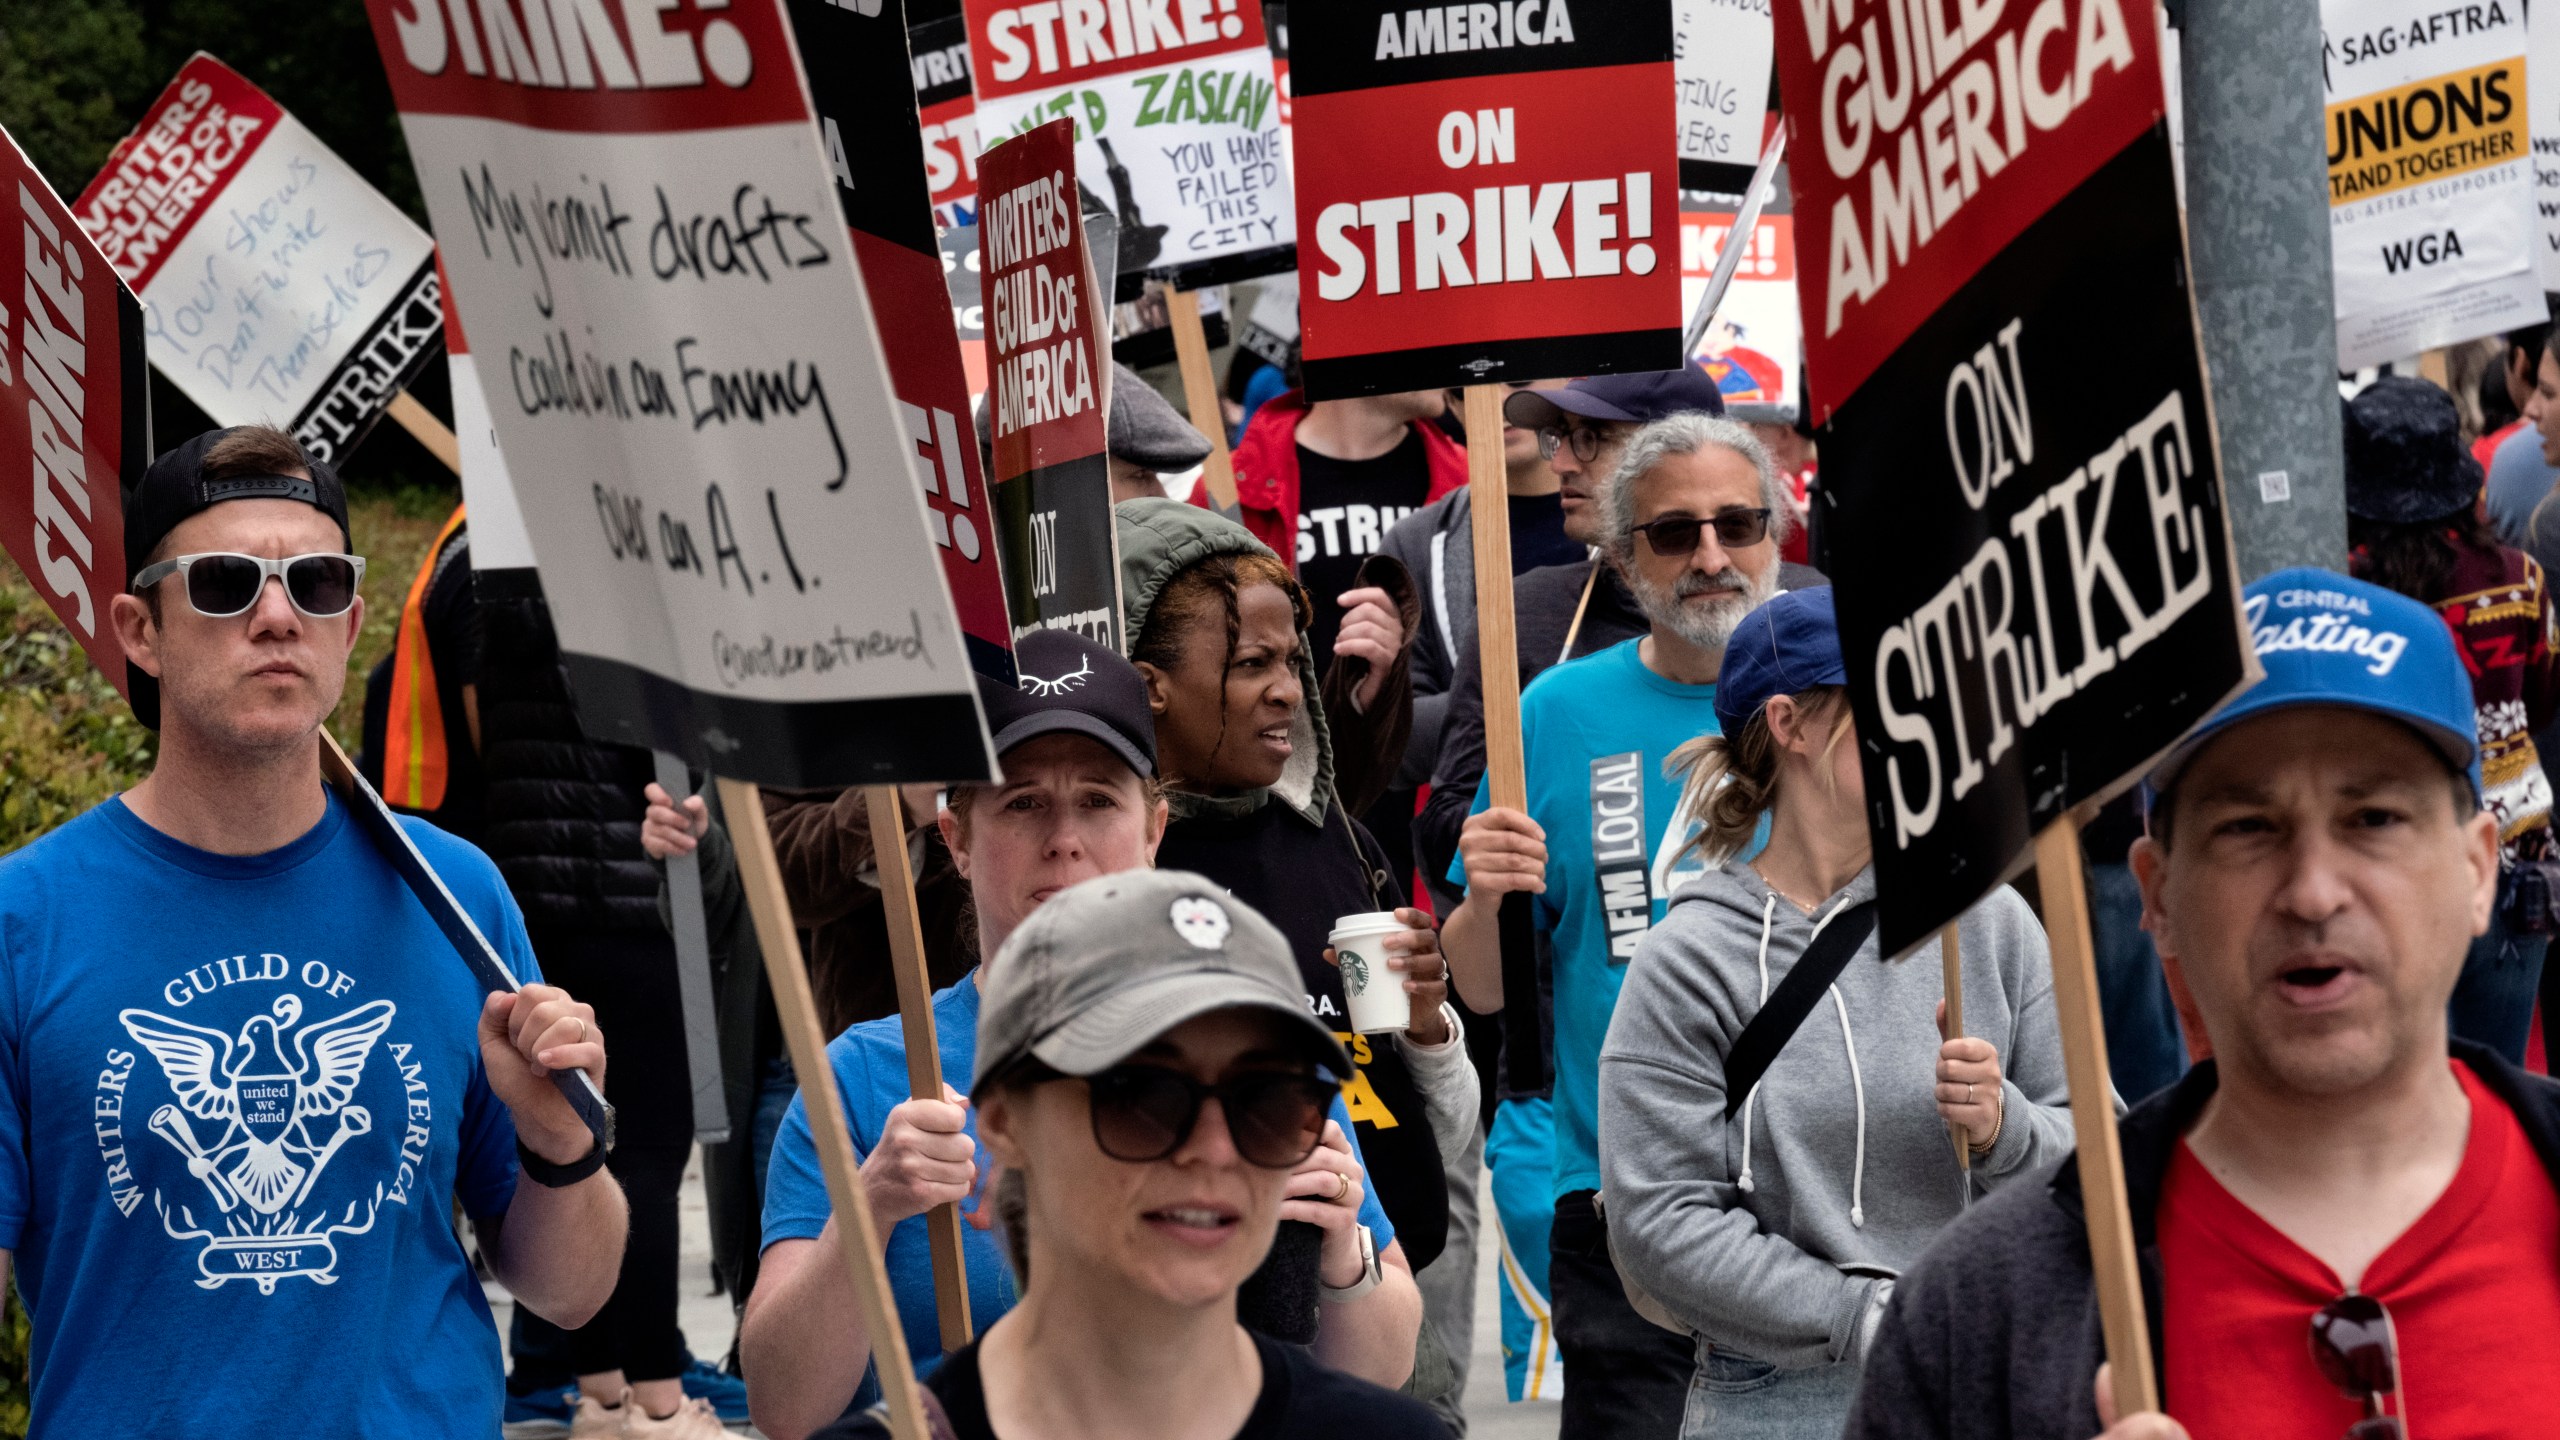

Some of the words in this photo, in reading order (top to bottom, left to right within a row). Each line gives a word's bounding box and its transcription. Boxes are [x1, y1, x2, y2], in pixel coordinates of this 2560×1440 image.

[986, 0, 1244, 82] STRIKE!
[1375, 0, 1574, 61] AMERICA
[1133, 69, 1274, 133] ZASLAV
[1675, 78, 1737, 116] TING
[1161, 142, 1213, 174] YOU
[1227, 128, 1280, 165] HAVE
[1438, 107, 1516, 169] ON
[1677, 121, 1731, 157] ERS
[1826, 0, 2135, 339] AMERICA
[2328, 163, 2392, 199] TAND
[2395, 130, 2515, 181] TOGETHER
[95, 143, 195, 262] GUILD
[190, 103, 228, 150] OF
[1177, 161, 1276, 206] FAILED
[1203, 195, 1260, 225] THIS
[2427, 165, 2519, 201] SUPPORTS
[460, 162, 555, 319] My
[649, 183, 832, 284] drafts
[985, 169, 1070, 274] WRITERS
[1188, 216, 1278, 251] CITY
[1315, 171, 1657, 301] STRIKE!
[2381, 228, 2464, 275] WGA
[993, 263, 1055, 356] GUILD
[1056, 274, 1078, 334] OF
[293, 271, 445, 463] STRIKE
[997, 336, 1095, 438] AMERICA
[18, 180, 96, 639] STRIKE!
[629, 357, 678, 420] an
[675, 336, 849, 493] Emmy
[1945, 316, 2033, 510] ON
[657, 510, 706, 580] an
[1028, 510, 1057, 599] ON
[1875, 390, 2213, 850] STRIKE
[2276, 588, 2372, 616] CENTRAL
[1596, 752, 1641, 862] LOCAL
[1600, 869, 1649, 958] AFM
[95, 1048, 145, 1218] WRITERS
[164, 953, 289, 1007] GUILD
[301, 960, 355, 999] OF
[386, 1042, 432, 1206] AMERICA
[242, 1083, 289, 1100] united
[246, 1109, 286, 1123] stand
[255, 1100, 276, 1111] we
[234, 1249, 302, 1270] WEST
